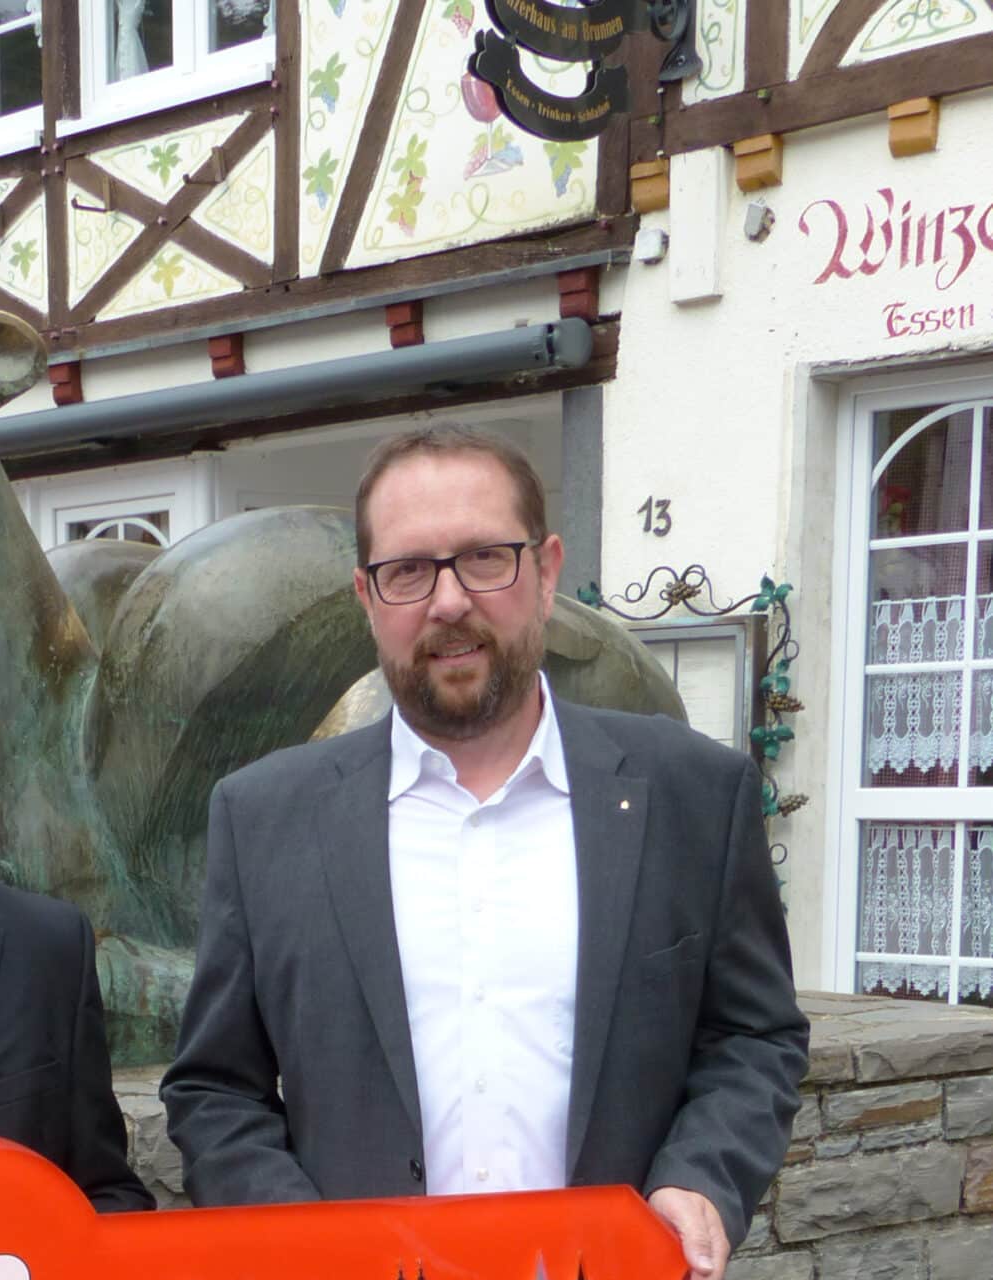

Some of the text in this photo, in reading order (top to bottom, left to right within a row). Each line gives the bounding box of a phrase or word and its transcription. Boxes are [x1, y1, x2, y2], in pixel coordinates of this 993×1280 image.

[561, 22, 577, 40] am
[537, 102, 571, 122] Trinken
[881, 302, 974, 339] Essen
[637, 496, 671, 537] 13
